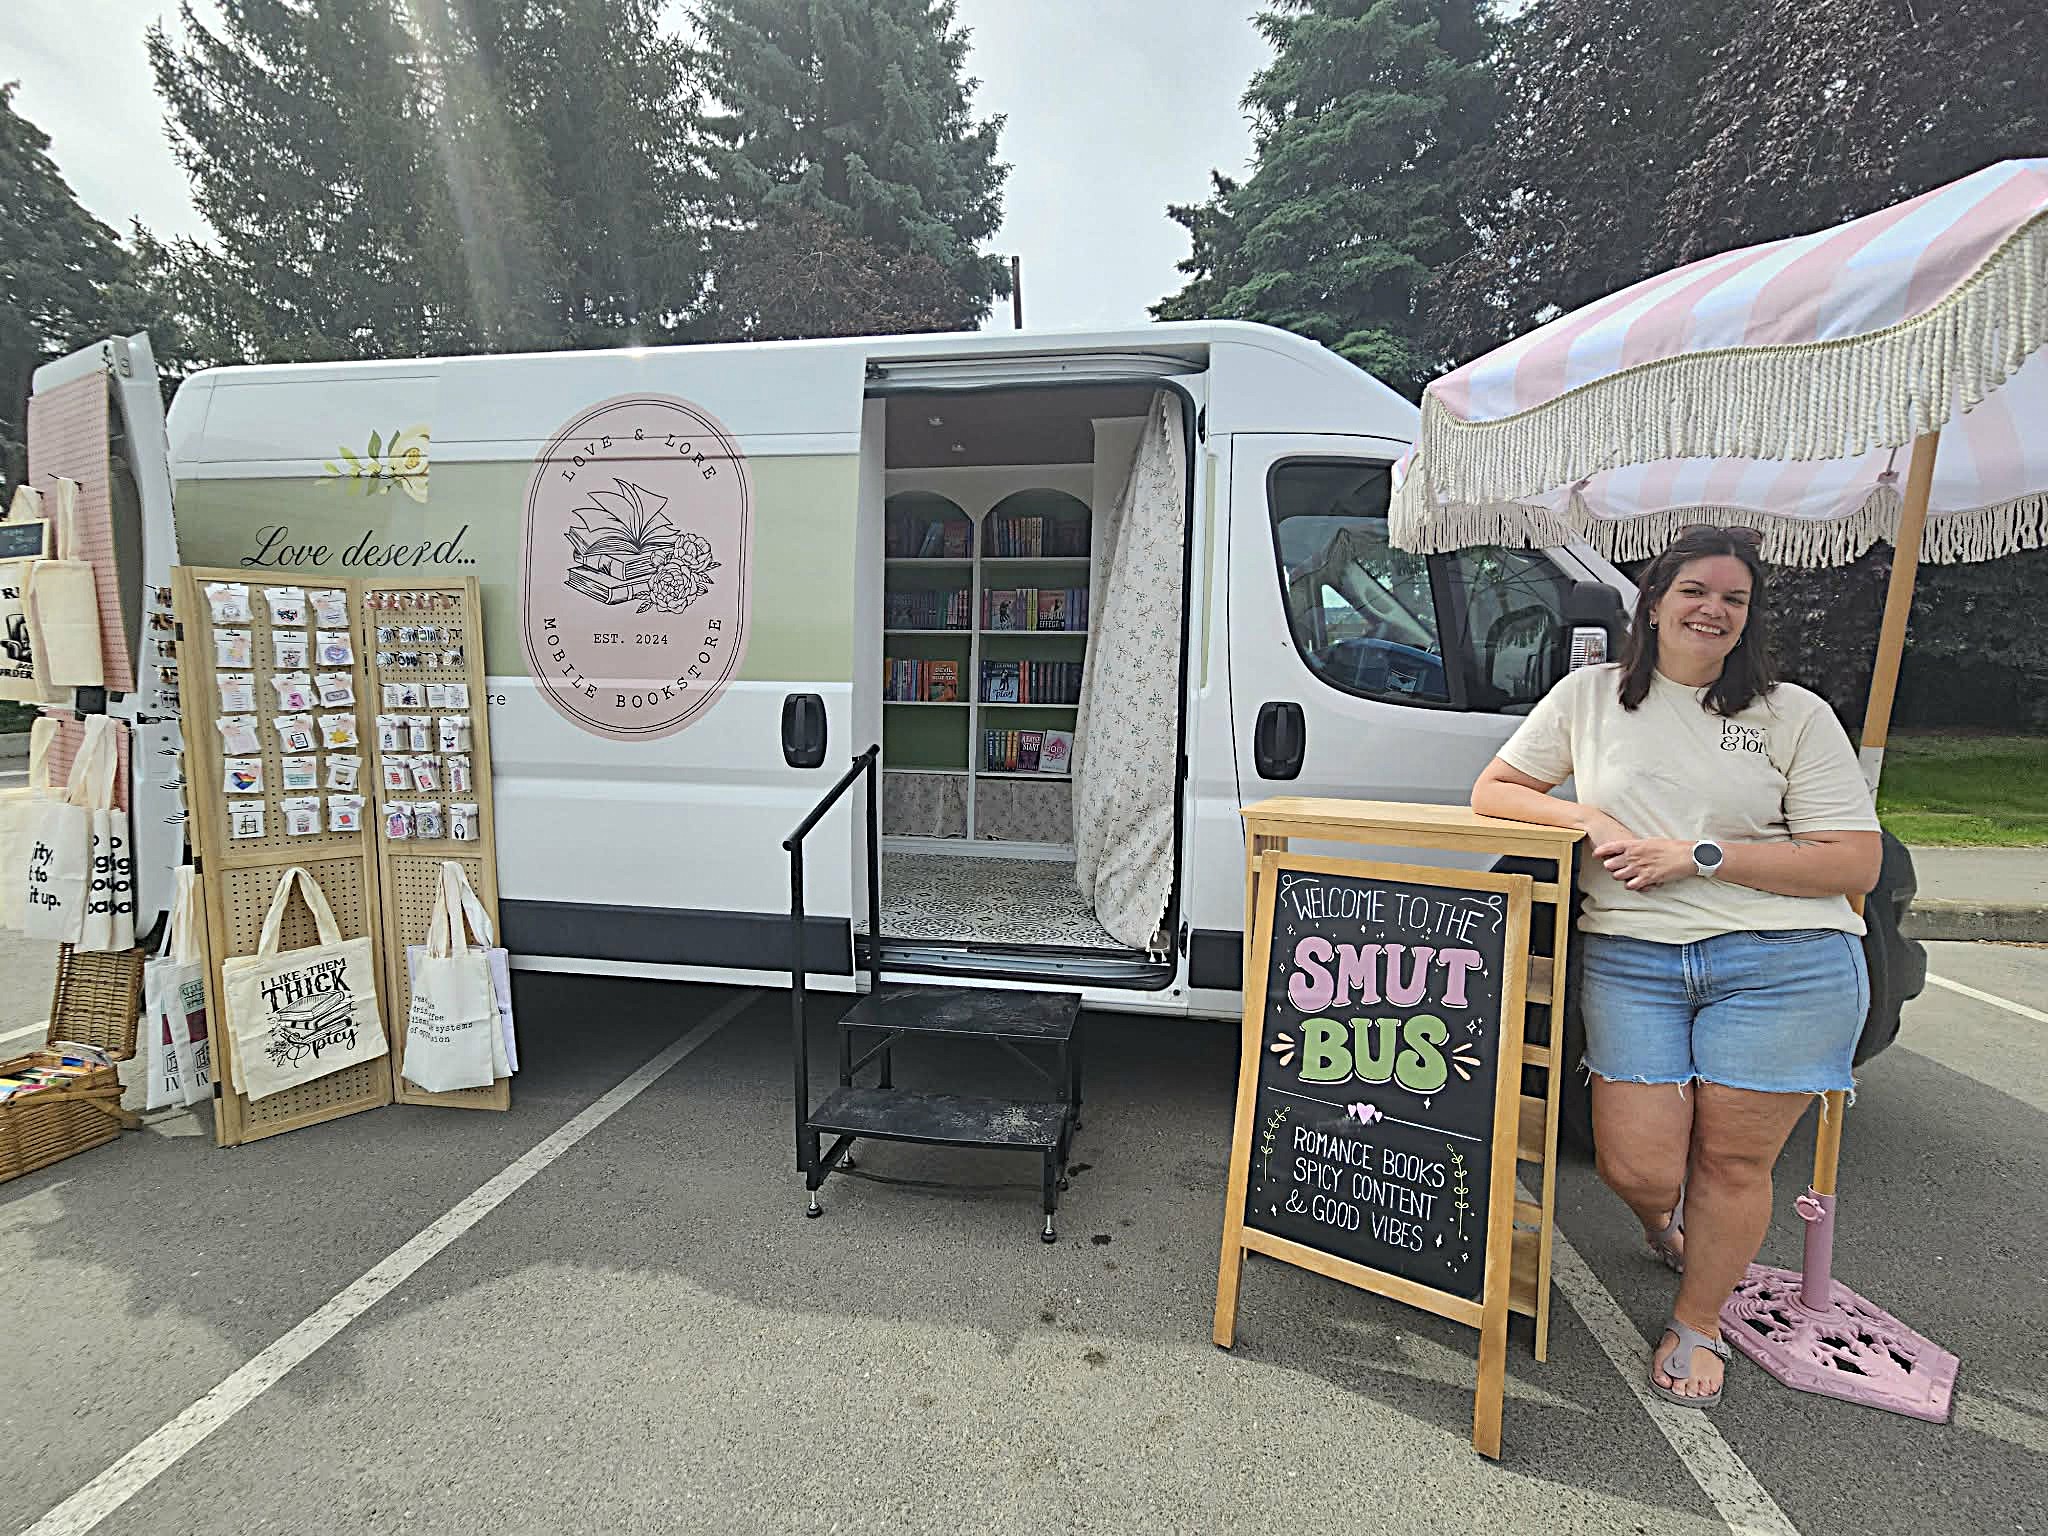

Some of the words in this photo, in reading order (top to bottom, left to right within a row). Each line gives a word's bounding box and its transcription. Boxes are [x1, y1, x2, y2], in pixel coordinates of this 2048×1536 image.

[562, 436, 612, 482] LOVE
[634, 428, 644, 441] &
[665, 434, 717, 480] LORE
[240, 525, 333, 567] Love
[544, 617, 598, 699] MOBILE
[616, 619, 722, 708] BOOKSTORE
[593, 633, 625, 644] EST.
[636, 633, 668, 645] 2024
[1720, 736, 1740, 751] &
[1721, 719, 1760, 738] love
[41, 892, 61, 911] up.
[1292, 887, 1387, 922] WELCOME
[1396, 893, 1429, 929] TO
[1436, 901, 1485, 944] THE
[261, 980, 265, 990] I
[270, 971, 300, 988] LIKE
[307, 957, 346, 976] THEM
[261, 966, 351, 1013] THICK
[1288, 936, 1483, 1013] SMUT
[286, 1028, 359, 1069] Spicy
[1298, 1014, 1450, 1094] BUS
[1293, 1126, 1374, 1171] ROMANCE
[1383, 1148, 1446, 1188] BOOKS
[1293, 1157, 1343, 1193] SPICY
[1352, 1173, 1438, 1221] CONTENT
[1285, 1189, 1308, 1214] &
[1312, 1194, 1360, 1231] GOOD
[1372, 1211, 1423, 1251] VIBES
